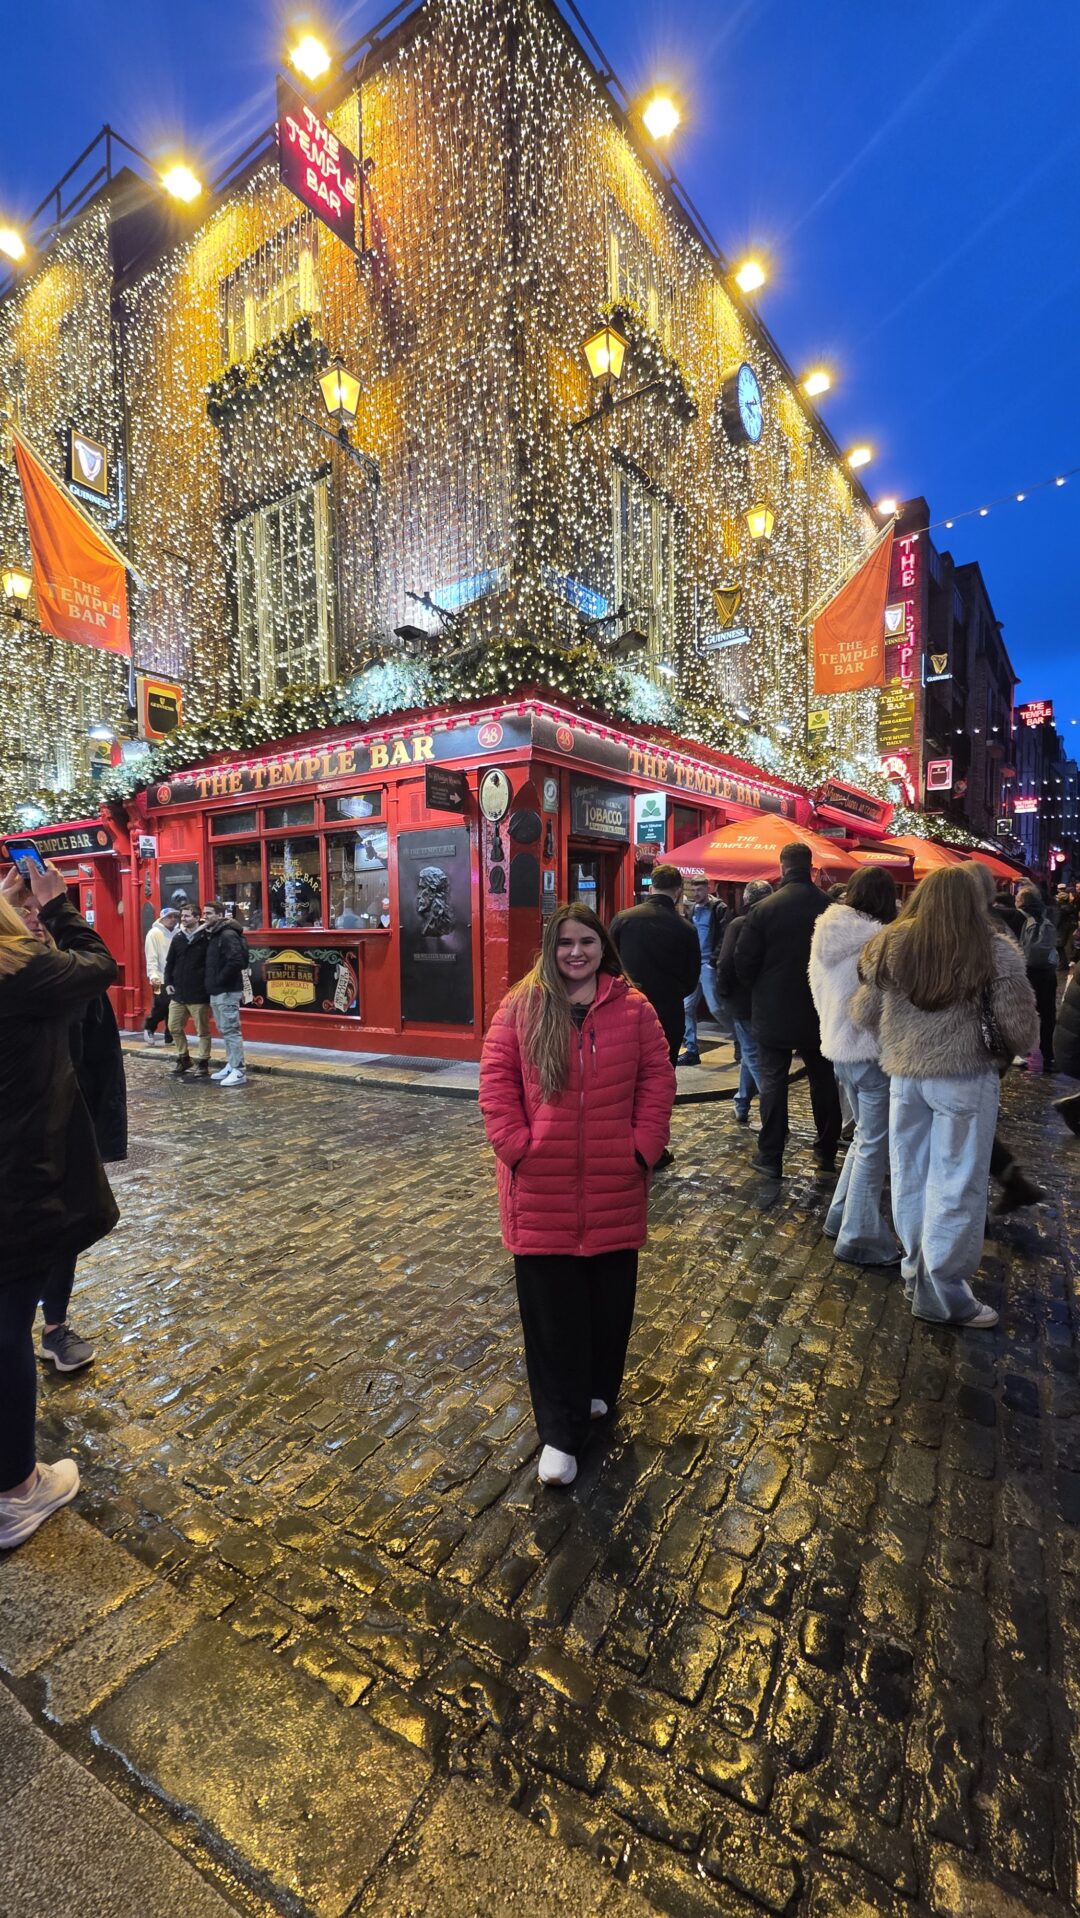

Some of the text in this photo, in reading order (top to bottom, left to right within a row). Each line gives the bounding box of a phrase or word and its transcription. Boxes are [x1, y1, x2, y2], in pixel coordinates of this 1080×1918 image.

[303, 105, 340, 161] THE
[286, 116, 356, 204] TEMPLE
[306, 168, 342, 217] BAR
[69, 484, 111, 510] GUINNESS
[900, 538, 915, 587] THE
[70, 577, 101, 597] THE
[44, 583, 121, 619] TEMPLE
[68, 604, 107, 628] BAR
[705, 628, 746, 644] GUINNESS
[838, 641, 863, 651] THE
[819, 645, 878, 665] TEMPLE
[833, 662, 865, 676] BAR
[880, 692, 915, 704] TEMPLE
[886, 702, 907, 711] BAR
[1027, 702, 1045, 711] THE
[1020, 708, 1051, 719] TEMPLE
[1026, 717, 1044, 726] BAR
[196, 772, 243, 798] THE
[250, 750, 356, 789] TEMPLE
[369, 736, 436, 769] BAR
[482, 728, 499, 744] 48
[560, 731, 570, 746] 48
[629, 751, 668, 781] THE
[673, 762, 732, 799] TEMPLE
[736, 784, 761, 808] BAR
[582, 800, 623, 826] TOBACCO
[70, 833, 92, 848] BAR
[737, 835, 760, 843] THE
[303, 873, 319, 893] BAR
[267, 971, 314, 981] TEMPLE BAR
